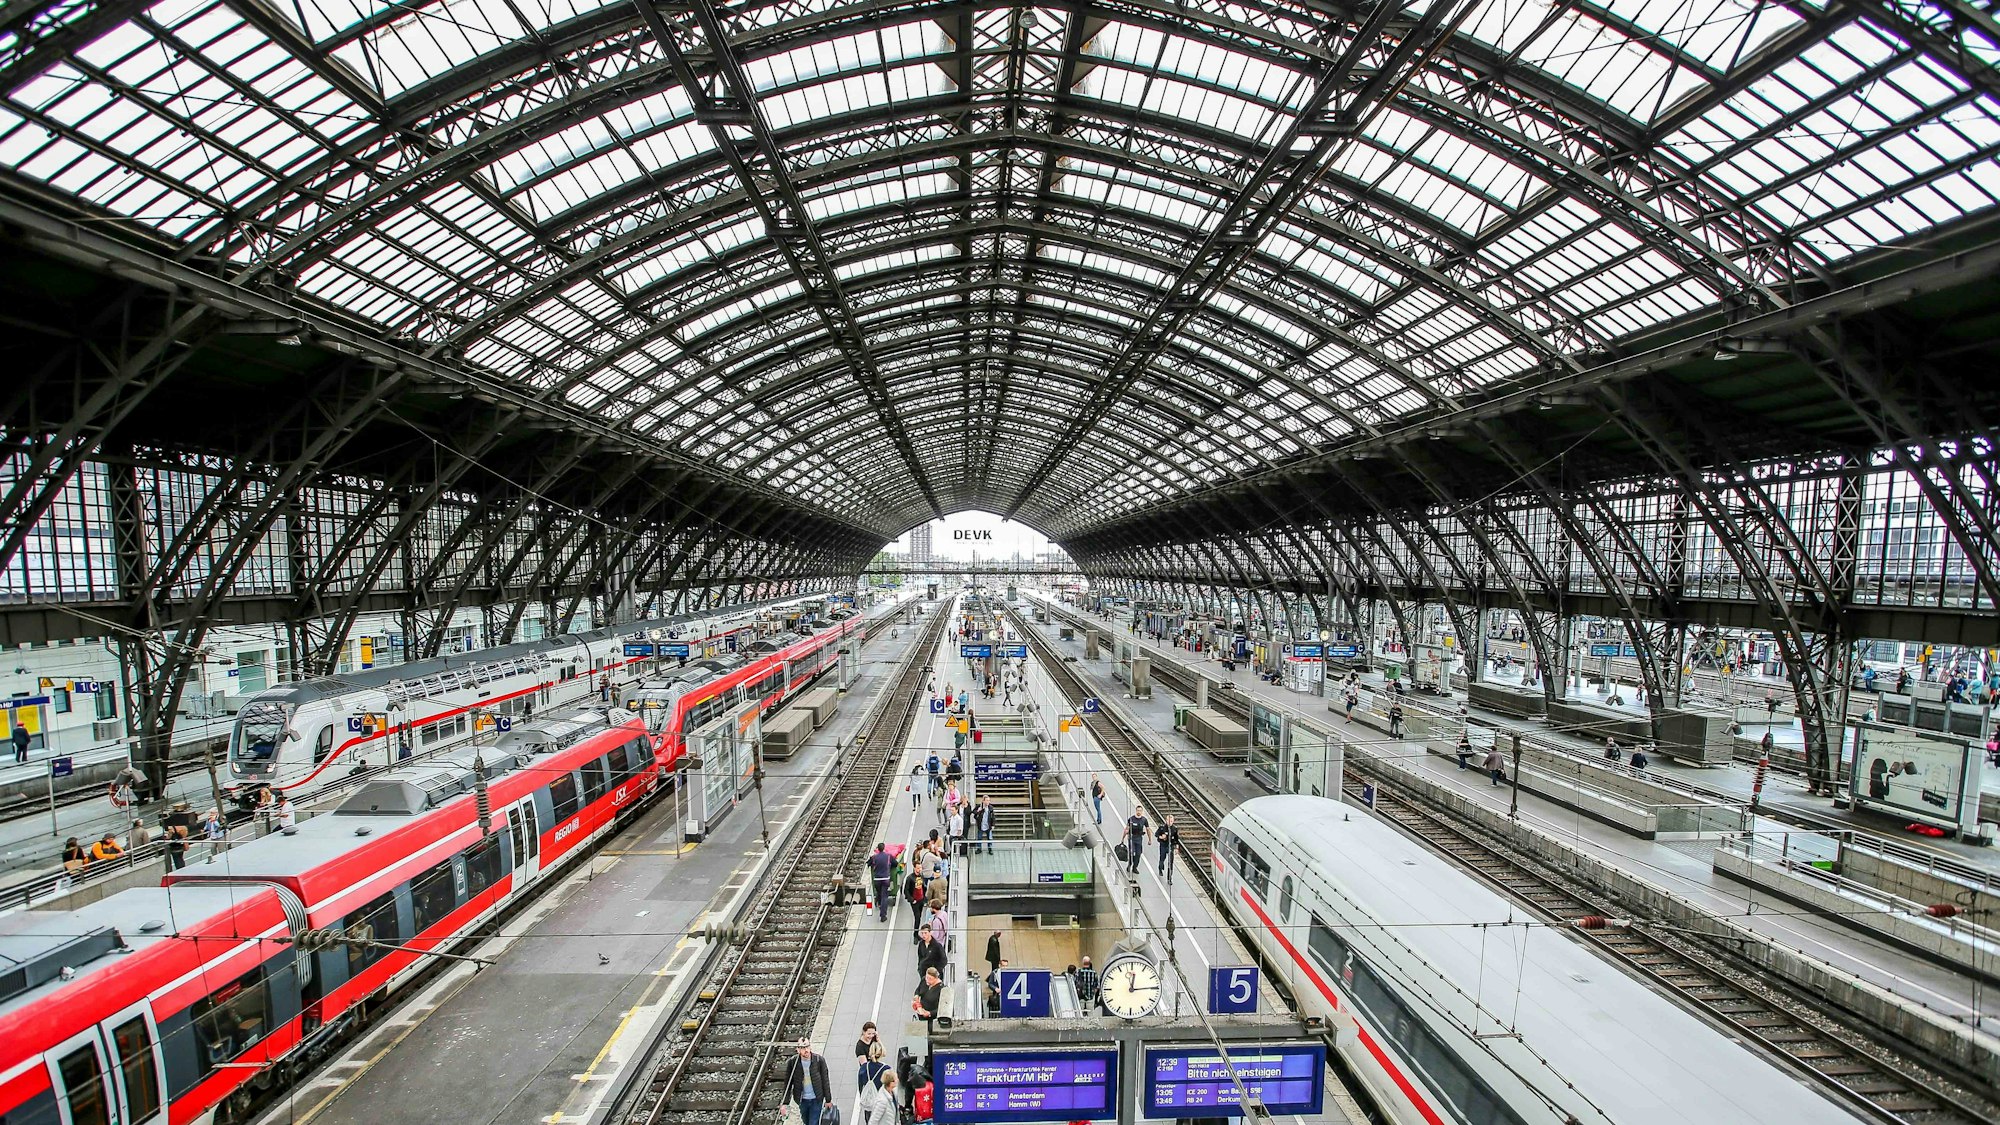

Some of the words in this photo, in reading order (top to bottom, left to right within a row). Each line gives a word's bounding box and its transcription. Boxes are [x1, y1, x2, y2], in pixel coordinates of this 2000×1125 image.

[954, 529, 992, 540] DEVK
[672, 631, 678, 639] 3
[1304, 632, 1309, 640] 6
[1340, 632, 1346, 640] 7
[1284, 644, 1290, 652] C
[1357, 644, 1363, 652] C
[80, 682, 87, 691] 1
[89, 682, 98, 691] C
[933, 699, 943, 711] C
[1084, 699, 1094, 710] C
[351, 718, 361, 730] C
[500, 717, 509, 730] C
[349, 748, 359, 763] IC
[554, 822, 572, 843] REGIO
[457, 864, 463, 876] 2
[1224, 866, 1240, 905] ICE
[1346, 950, 1354, 970] 2
[1007, 972, 1031, 1007] 4
[1228, 969, 1251, 1004] 5
[945, 1062, 967, 1070] 12:18
[1157, 1058, 1178, 1067] 12:39
[976, 1072, 1035, 1083] Frankfurt/M
[1037, 1072, 1054, 1082] Hbf
[1187, 1069, 1209, 1078] Bitte
[1211, 1069, 1231, 1078] nich
[1236, 1067, 1282, 1079] einsteigen
[945, 1093, 963, 1101] 12:41
[1008, 1092, 1046, 1100] Amsterdam
[1030, 1100, 1042, 1108] (W)
